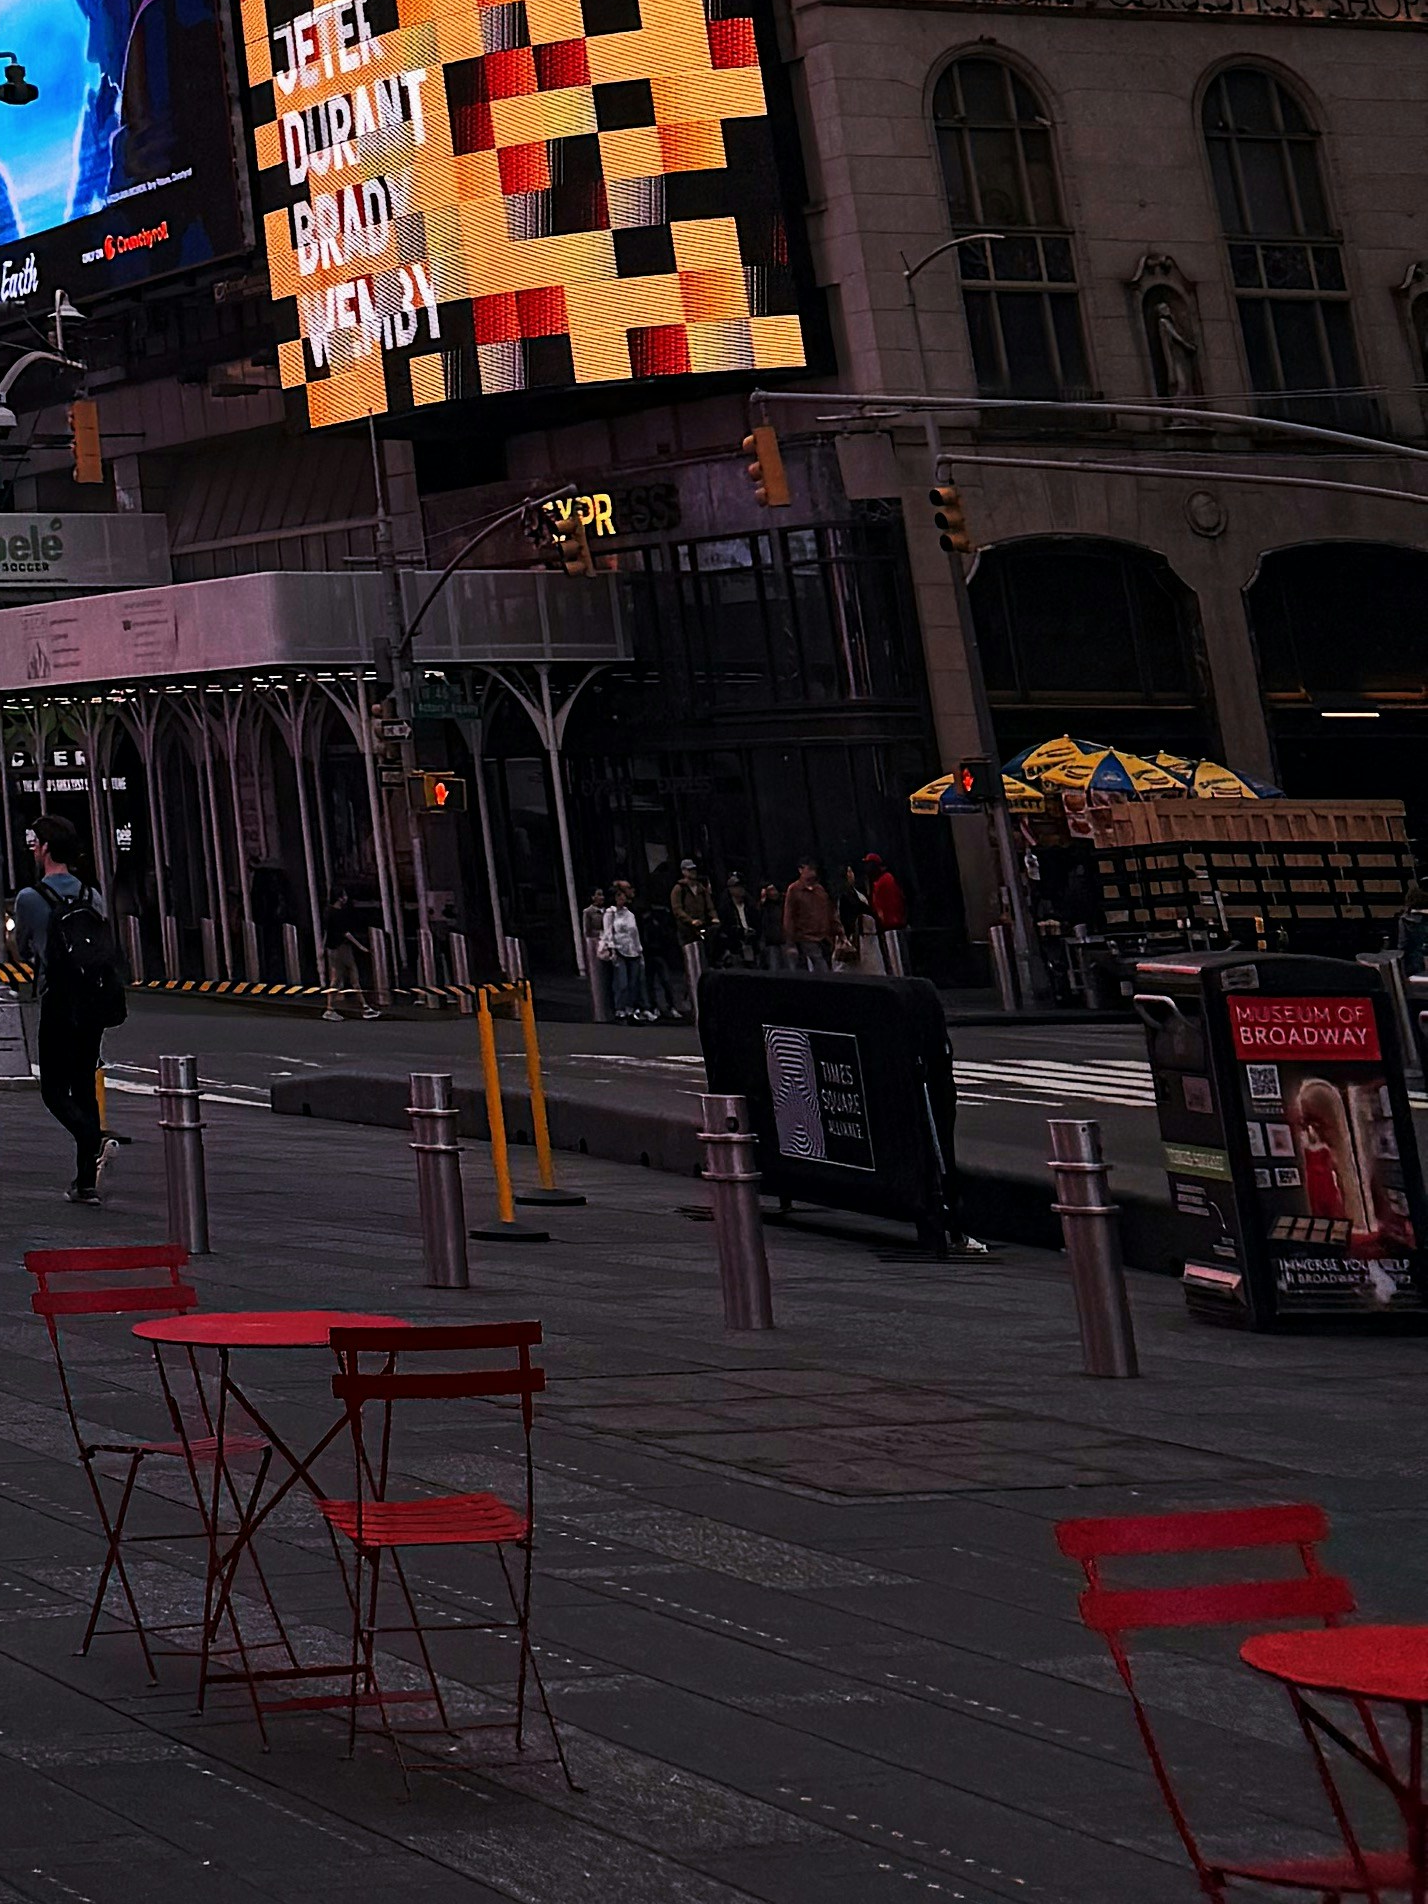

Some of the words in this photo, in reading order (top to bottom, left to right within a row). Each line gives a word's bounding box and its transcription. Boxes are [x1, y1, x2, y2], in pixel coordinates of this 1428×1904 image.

[279, 68, 427, 187] DURANT
[293, 173, 412, 277] BRADY
[2, 562, 50, 573] SOCCER
[1236, 1005, 1331, 1024] MUSEUM
[1338, 1006, 1366, 1023] OF
[1240, 1026, 1368, 1046] BROADWAY
